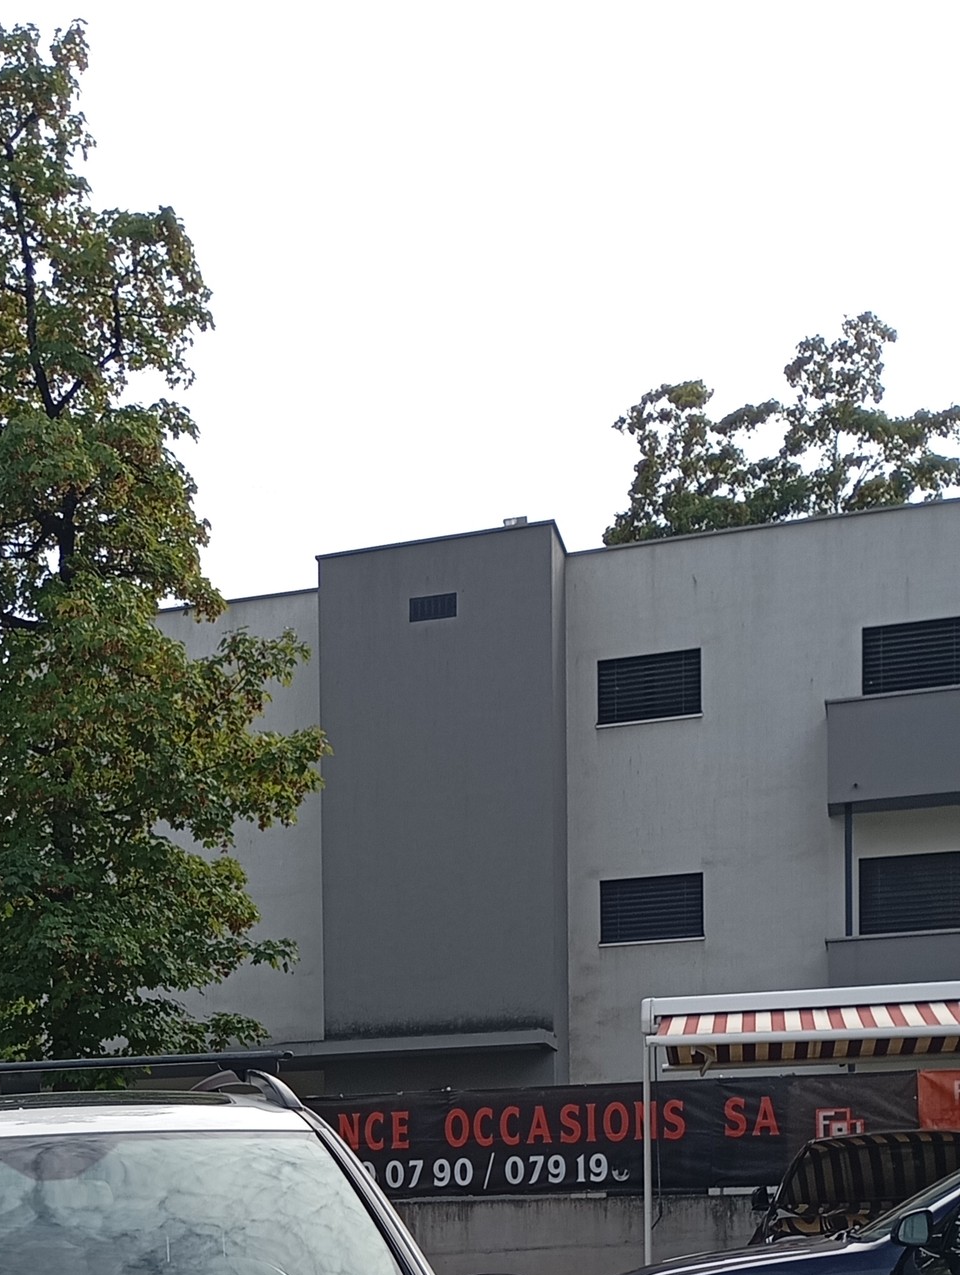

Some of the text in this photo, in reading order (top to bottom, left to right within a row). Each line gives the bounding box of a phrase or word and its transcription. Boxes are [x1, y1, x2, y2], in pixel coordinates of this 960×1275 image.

[444, 1099, 686, 1148] OCCASIONS
[723, 1095, 780, 1138] SA
[385, 1160, 424, 1188] 07
[433, 1157, 473, 1187] 90
[504, 1154, 566, 1185] 079
